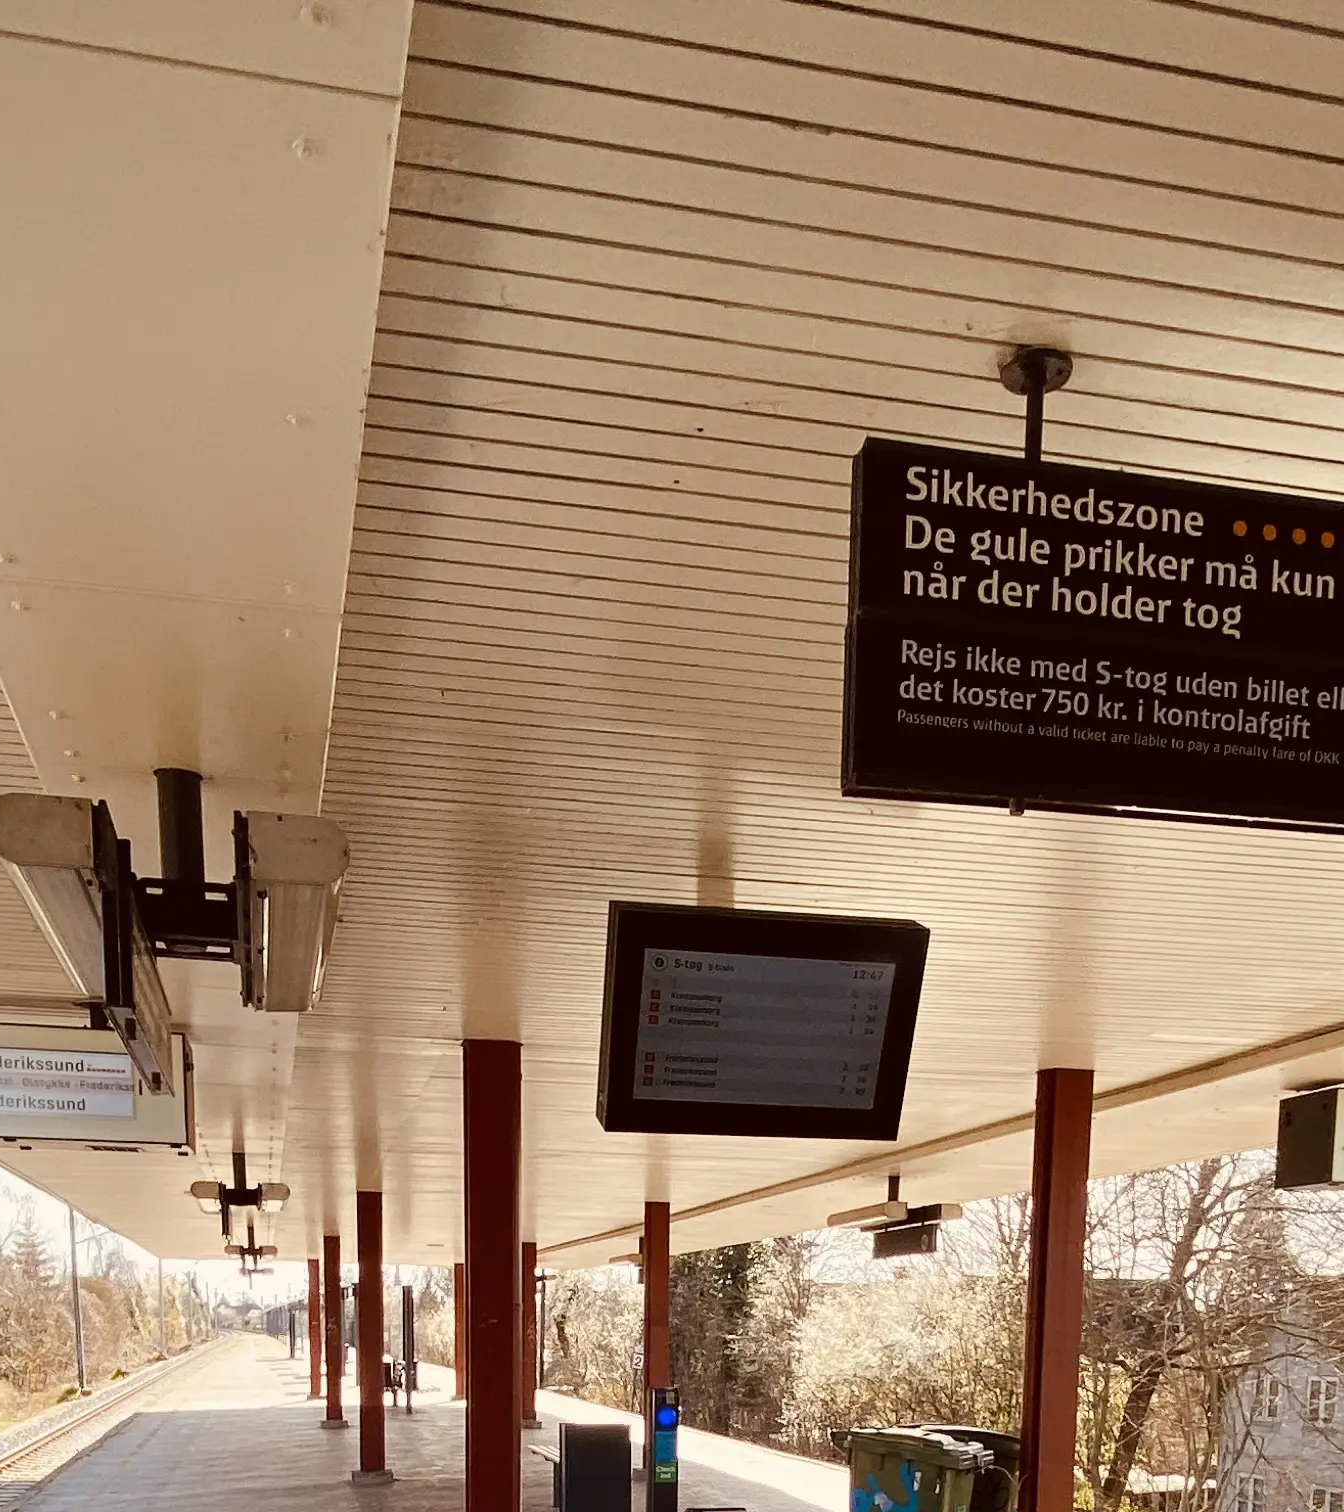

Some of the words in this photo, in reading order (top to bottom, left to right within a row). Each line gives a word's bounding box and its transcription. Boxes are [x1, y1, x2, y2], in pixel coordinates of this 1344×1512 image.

[906, 466, 1204, 536] Sikkerhedszone
[906, 515, 955, 553] De
[970, 528, 1050, 565] gule
[1064, 540, 1194, 581] prikker
[1206, 554, 1257, 590] må
[1271, 559, 1335, 599] kun
[904, 562, 966, 600] når
[977, 570, 1040, 608] der
[1051, 577, 1172, 623] holder
[1183, 599, 1242, 639] tog
[901, 639, 956, 673] Rejs
[966, 646, 1021, 675] ikke
[1030, 658, 1087, 682] med
[1095, 661, 1168, 696] S-tog
[1176, 672, 1237, 699] uden
[1247, 677, 1310, 706] billet
[897, 709, 969, 729] Passengers
[972, 719, 1023, 734] without
[1027, 725, 1035, 735] a
[1038, 725, 1069, 738] valid
[1111, 732, 1131, 744] are
[1171, 738, 1184, 749] to
[1188, 740, 1209, 754] pay
[1213, 743, 1220, 753] a
[1223, 743, 1269, 759] penalty
[1314, 751, 1340, 765] DKK
[899, 674, 943, 702] det
[952, 678, 1037, 711] koster
[1041, 688, 1090, 716] 750
[1097, 693, 1128, 721] kr.
[1138, 699, 1144, 722] i
[1153, 700, 1311, 741] kontrolafgift
[634, 1356, 642, 1368] 2
